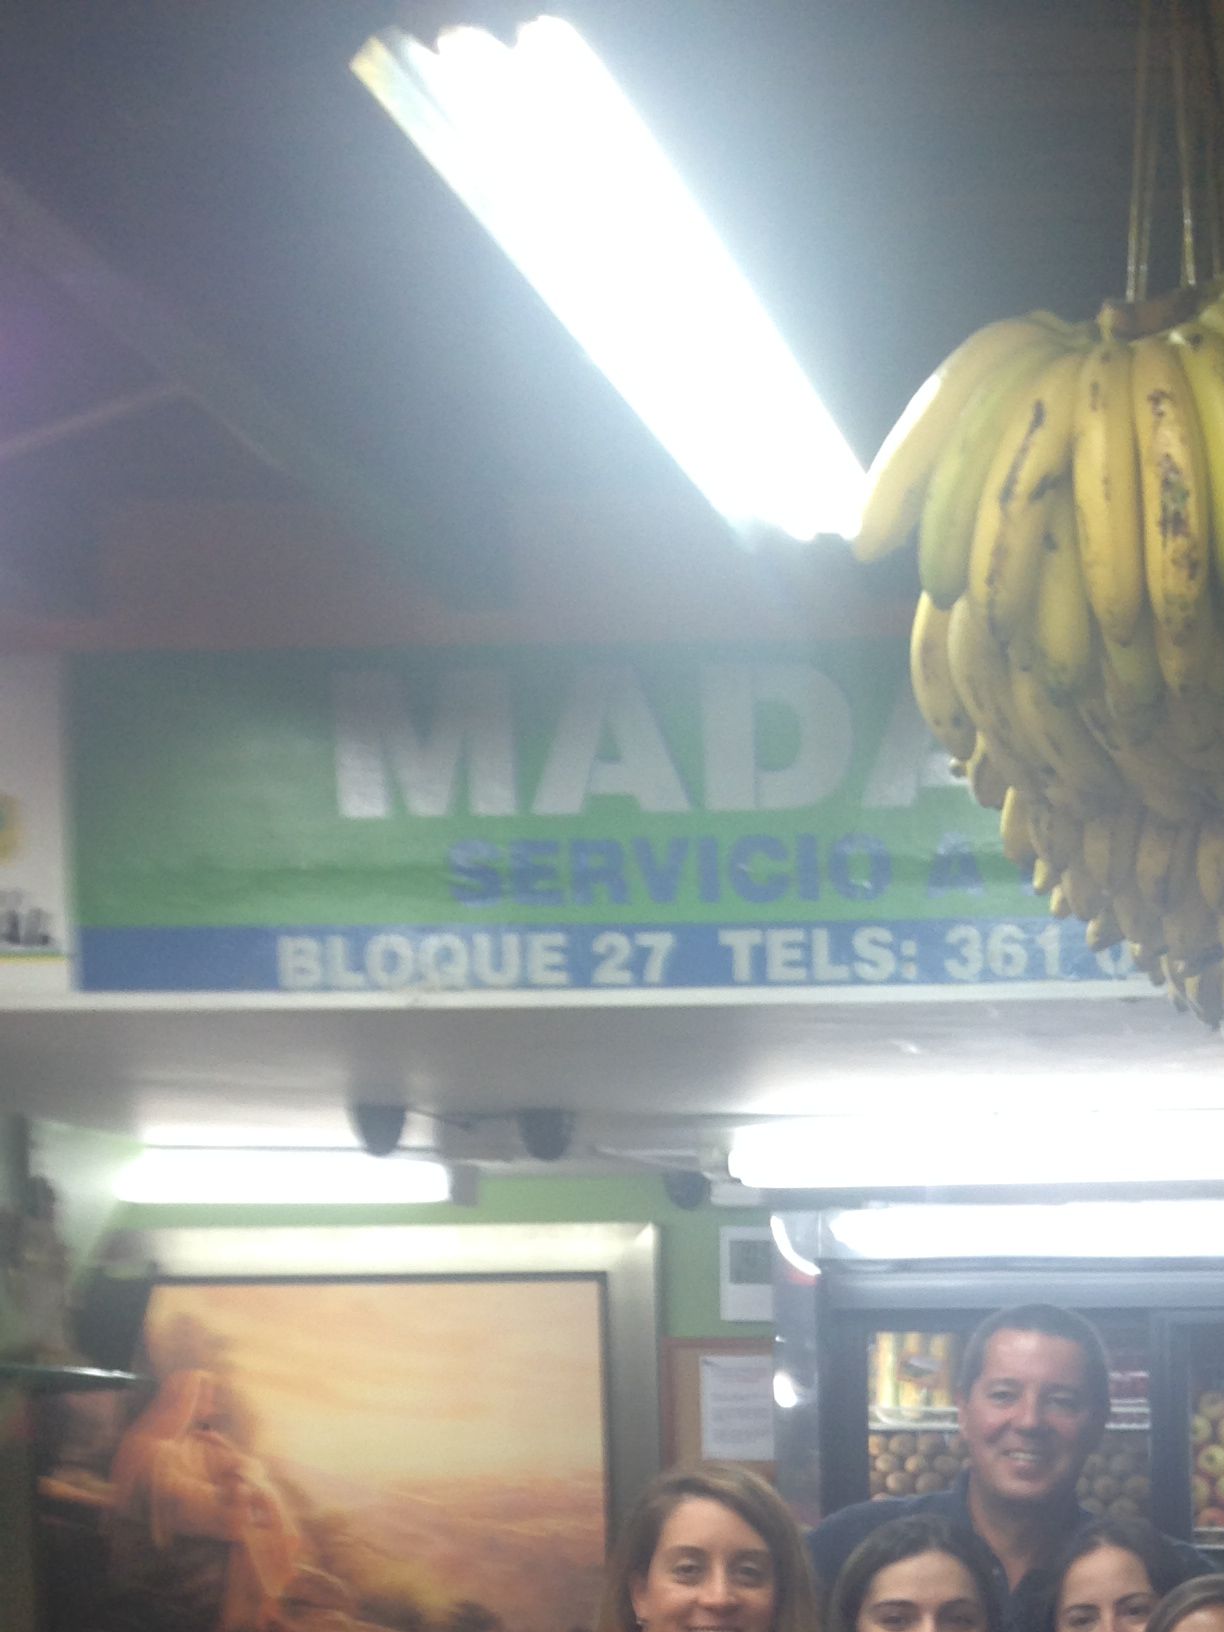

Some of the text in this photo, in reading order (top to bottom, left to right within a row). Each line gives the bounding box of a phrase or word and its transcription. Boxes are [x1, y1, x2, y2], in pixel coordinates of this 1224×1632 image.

[449, 831, 893, 908] SERVICIO
[927, 832, 986, 898] A
[276, 931, 570, 989] BLOQUE
[590, 930, 676, 986] 27
[717, 925, 918, 983] TELS:
[943, 923, 1063, 981] 361
